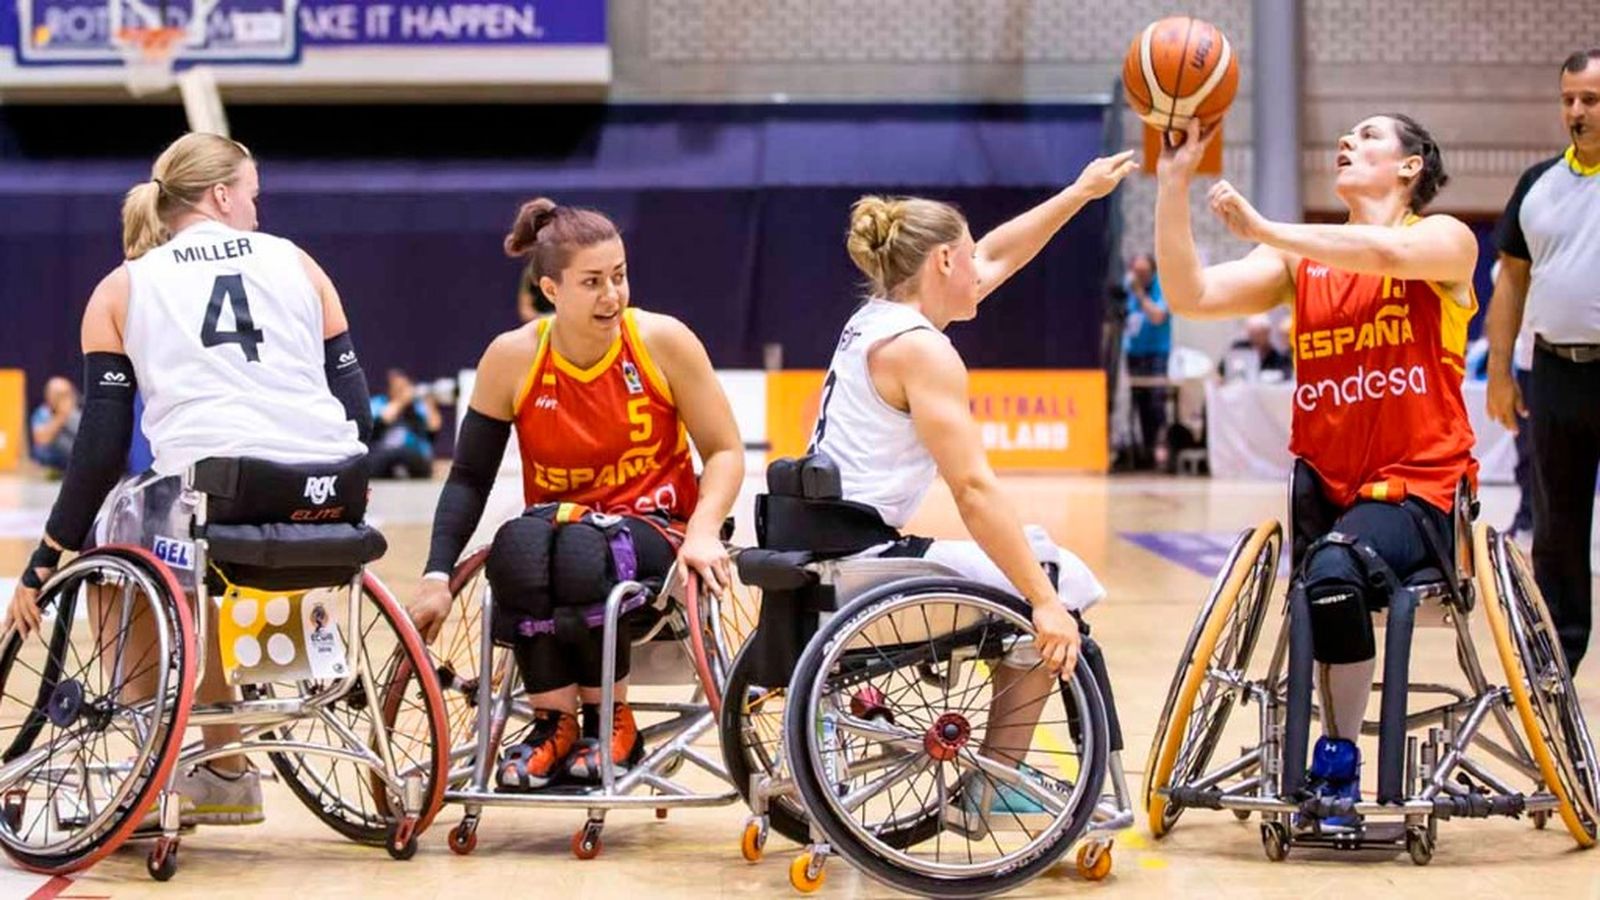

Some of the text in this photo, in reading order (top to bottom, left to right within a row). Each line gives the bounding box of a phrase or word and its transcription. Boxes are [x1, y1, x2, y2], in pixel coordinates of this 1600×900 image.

[365, 5, 394, 38] IT
[173, 237, 252, 263] MILLER
[200, 273, 264, 363] 4
[1298, 304, 1415, 360] ESPAÑA
[1296, 365, 1427, 411] endesa
[627, 397, 653, 442] 5
[968, 396, 1076, 416] KETBALL
[981, 423, 1068, 450] RLAND
[290, 506, 345, 521] ELITE
[154, 539, 189, 567] GEL
